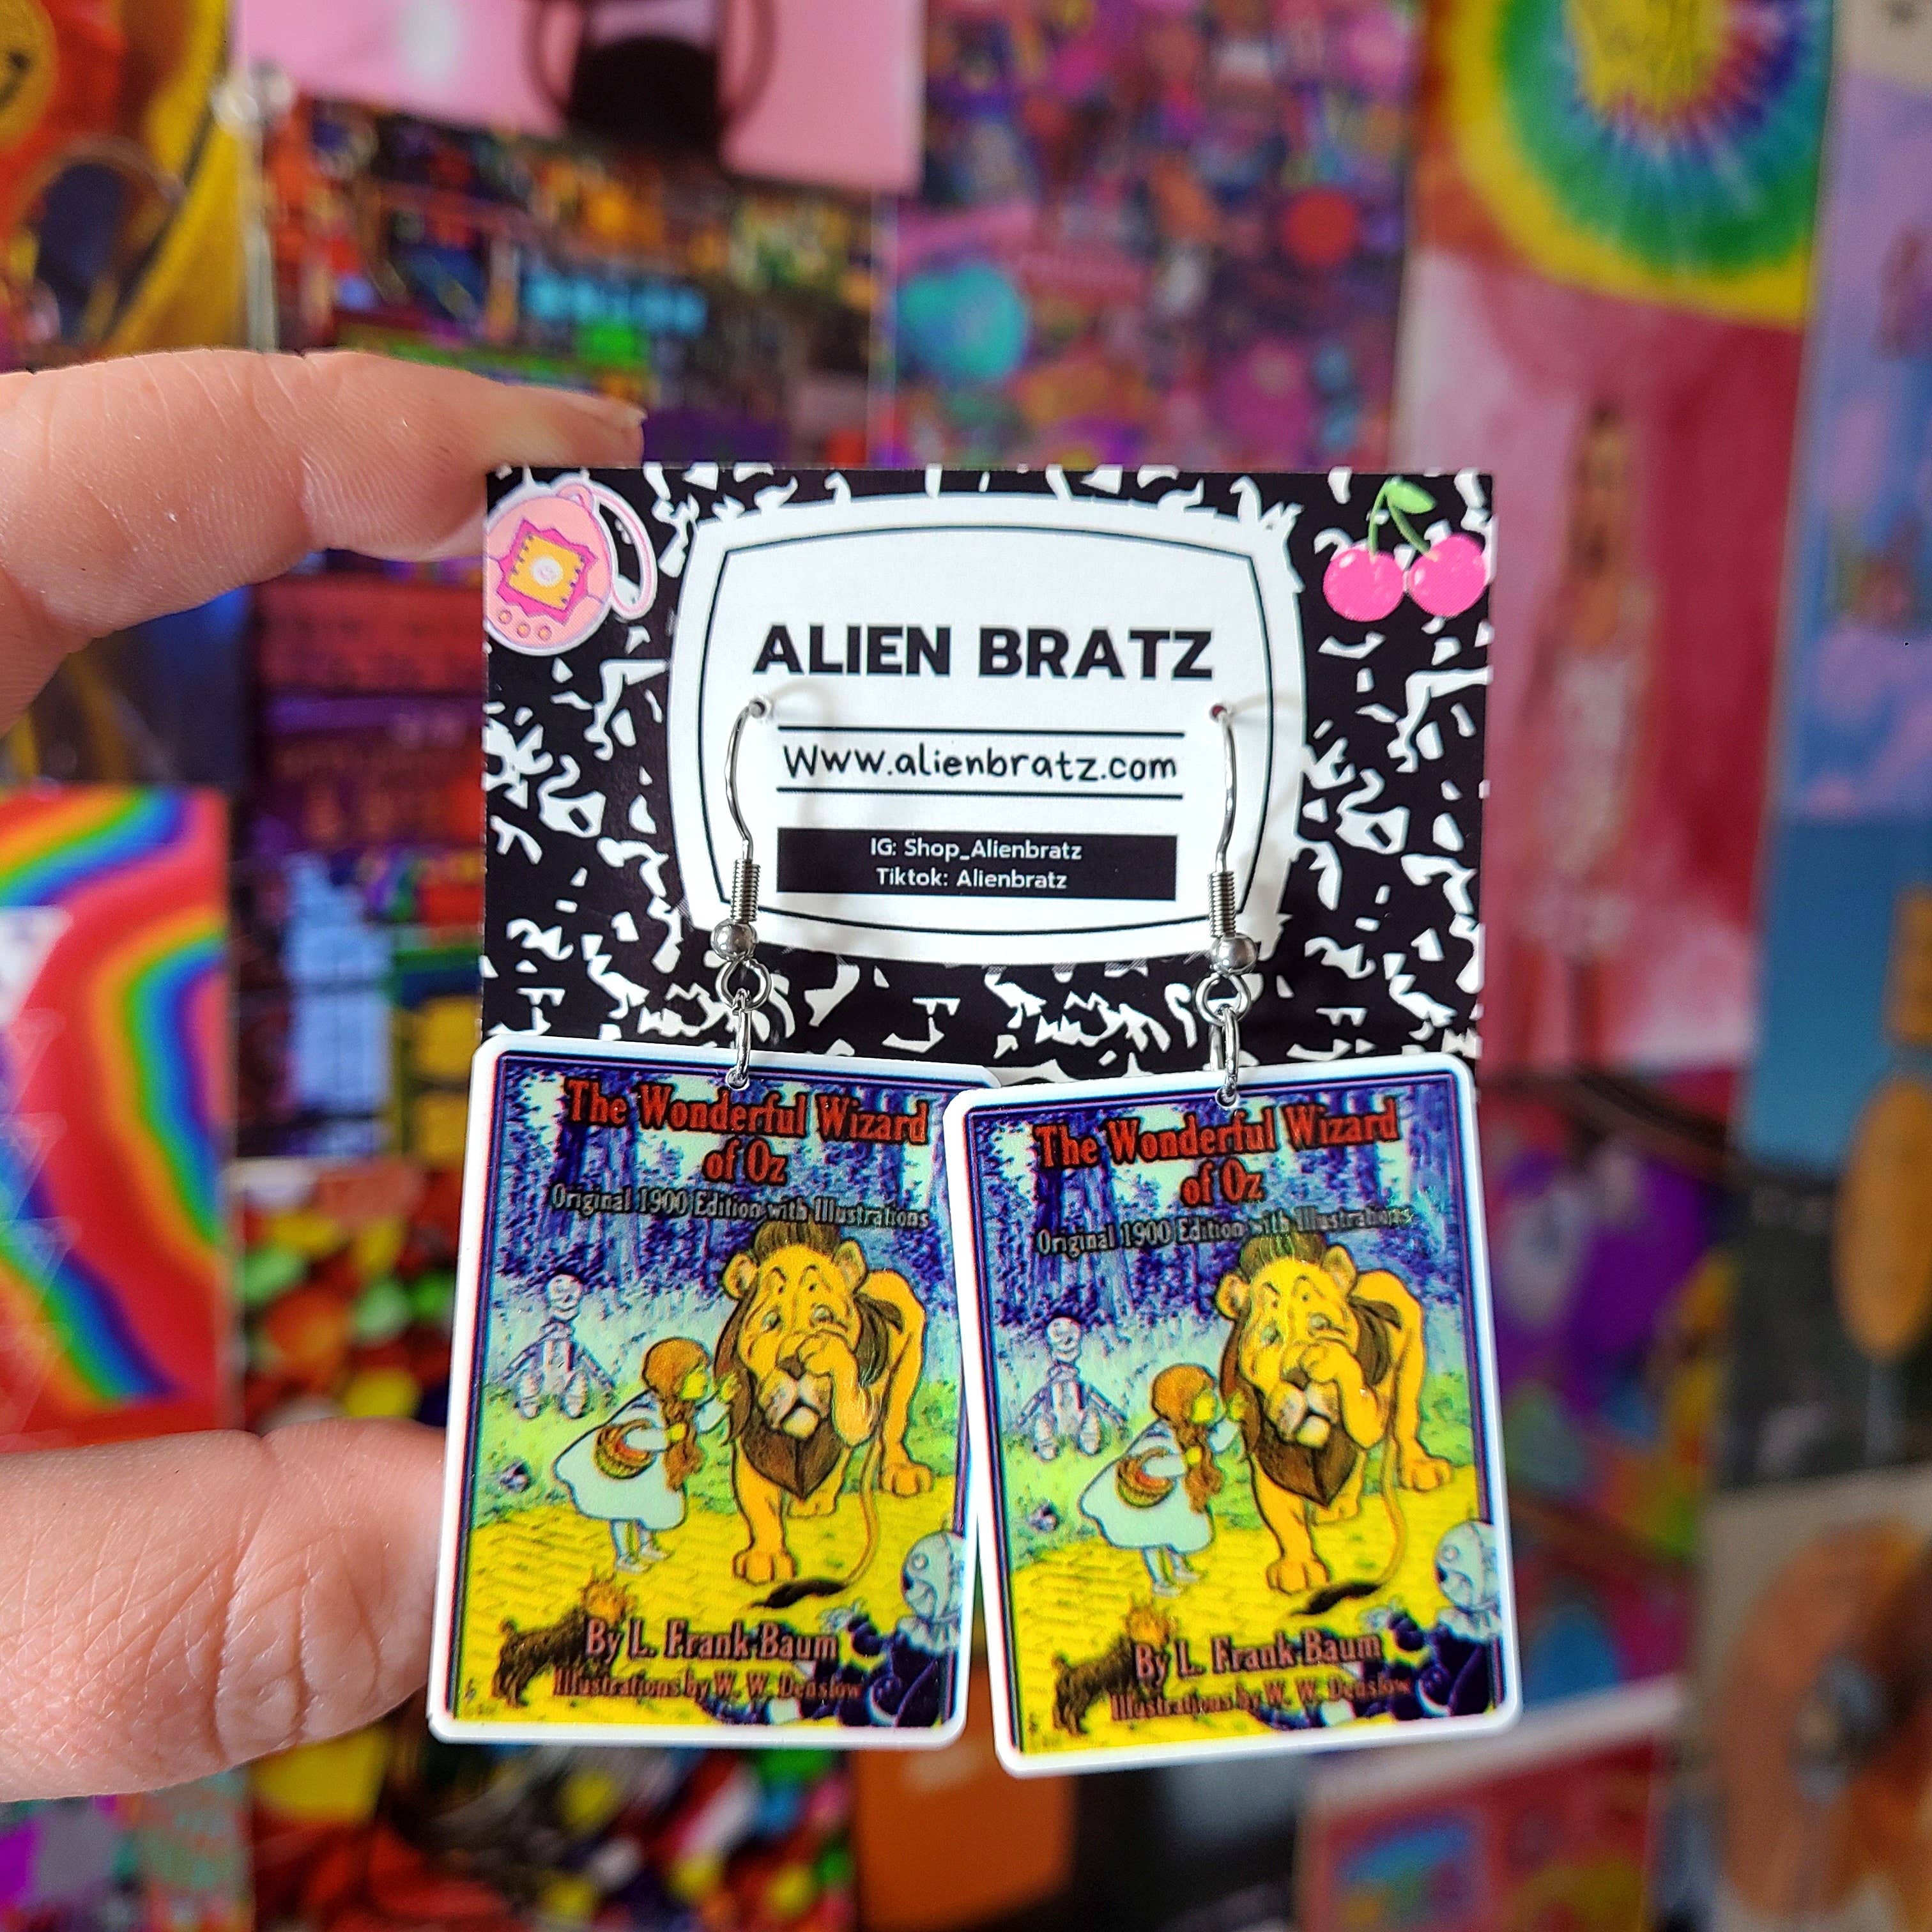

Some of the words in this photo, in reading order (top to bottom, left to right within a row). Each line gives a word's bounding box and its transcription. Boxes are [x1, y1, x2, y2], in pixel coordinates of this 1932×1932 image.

[753, 625, 951, 675] ALIEN
[979, 627, 1213, 680] BRATZ
[783, 742, 1176, 780] Www.alienbratz.com
[871, 838, 896, 857] IG:
[905, 838, 1082, 861] Shop_Alienbratz
[877, 868, 947, 887] Tiktok:
[957, 869, 1067, 889] Alienbratz
[565, 1078, 627, 1127] The
[638, 1082, 807, 1137] Wonderful
[815, 1093, 930, 1144] Wizard
[1034, 1122, 1099, 1168] The
[1105, 1108, 1276, 1164] Wonderful
[1282, 1097, 1399, 1150] Wizard
[703, 1137, 738, 1181] of
[745, 1138, 786, 1185] Oz
[1180, 1159, 1215, 1207] of
[1220, 1158, 1264, 1203] Oz
[551, 1186, 631, 1215] Original
[640, 1189, 687, 1216] 1900
[694, 1192, 766, 1220] Edition
[767, 1197, 808, 1222] with
[813, 1198, 929, 1229] Illustrations
[1038, 1226, 1115, 1257] Original
[1120, 1218, 1170, 1247] 1900
[1177, 1215, 1244, 1244] Edition
[586, 1617, 621, 1661] By
[627, 1618, 656, 1658] L.
[664, 1618, 752, 1660] Frank
[758, 1620, 839, 1660] Baum
[1135, 1642, 1168, 1685] By
[1176, 1639, 1204, 1677] L.
[1213, 1629, 1296, 1674] Frank
[1303, 1628, 1383, 1662] Baum
[553, 1666, 678, 1697] Illustrations
[684, 1668, 709, 1699] by
